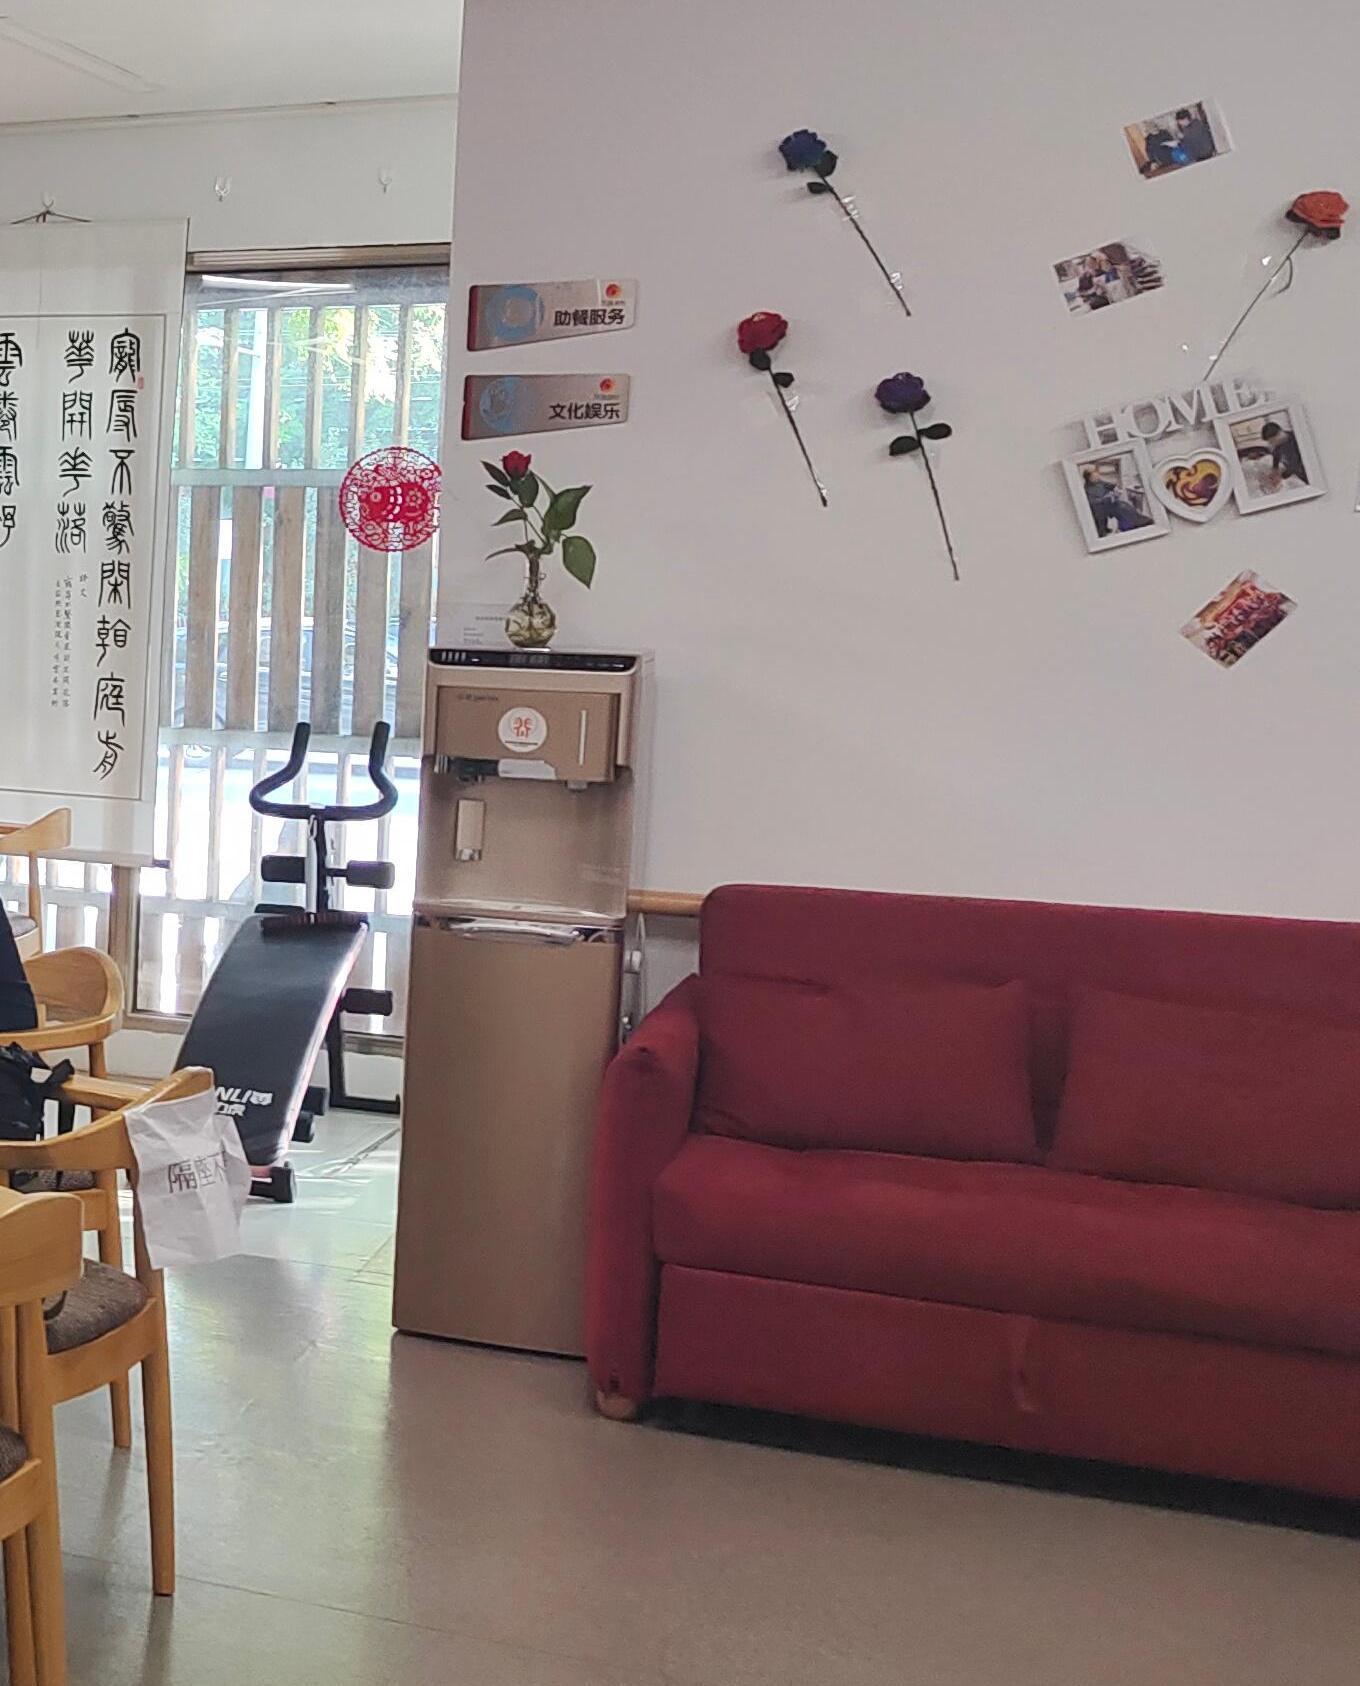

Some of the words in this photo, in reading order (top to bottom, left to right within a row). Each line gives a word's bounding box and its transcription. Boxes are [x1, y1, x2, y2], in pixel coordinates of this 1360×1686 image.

[554, 308, 625, 327] 助餐服务
[548, 402, 621, 420] 文化娱乐
[1083, 379, 1272, 449] HOME
